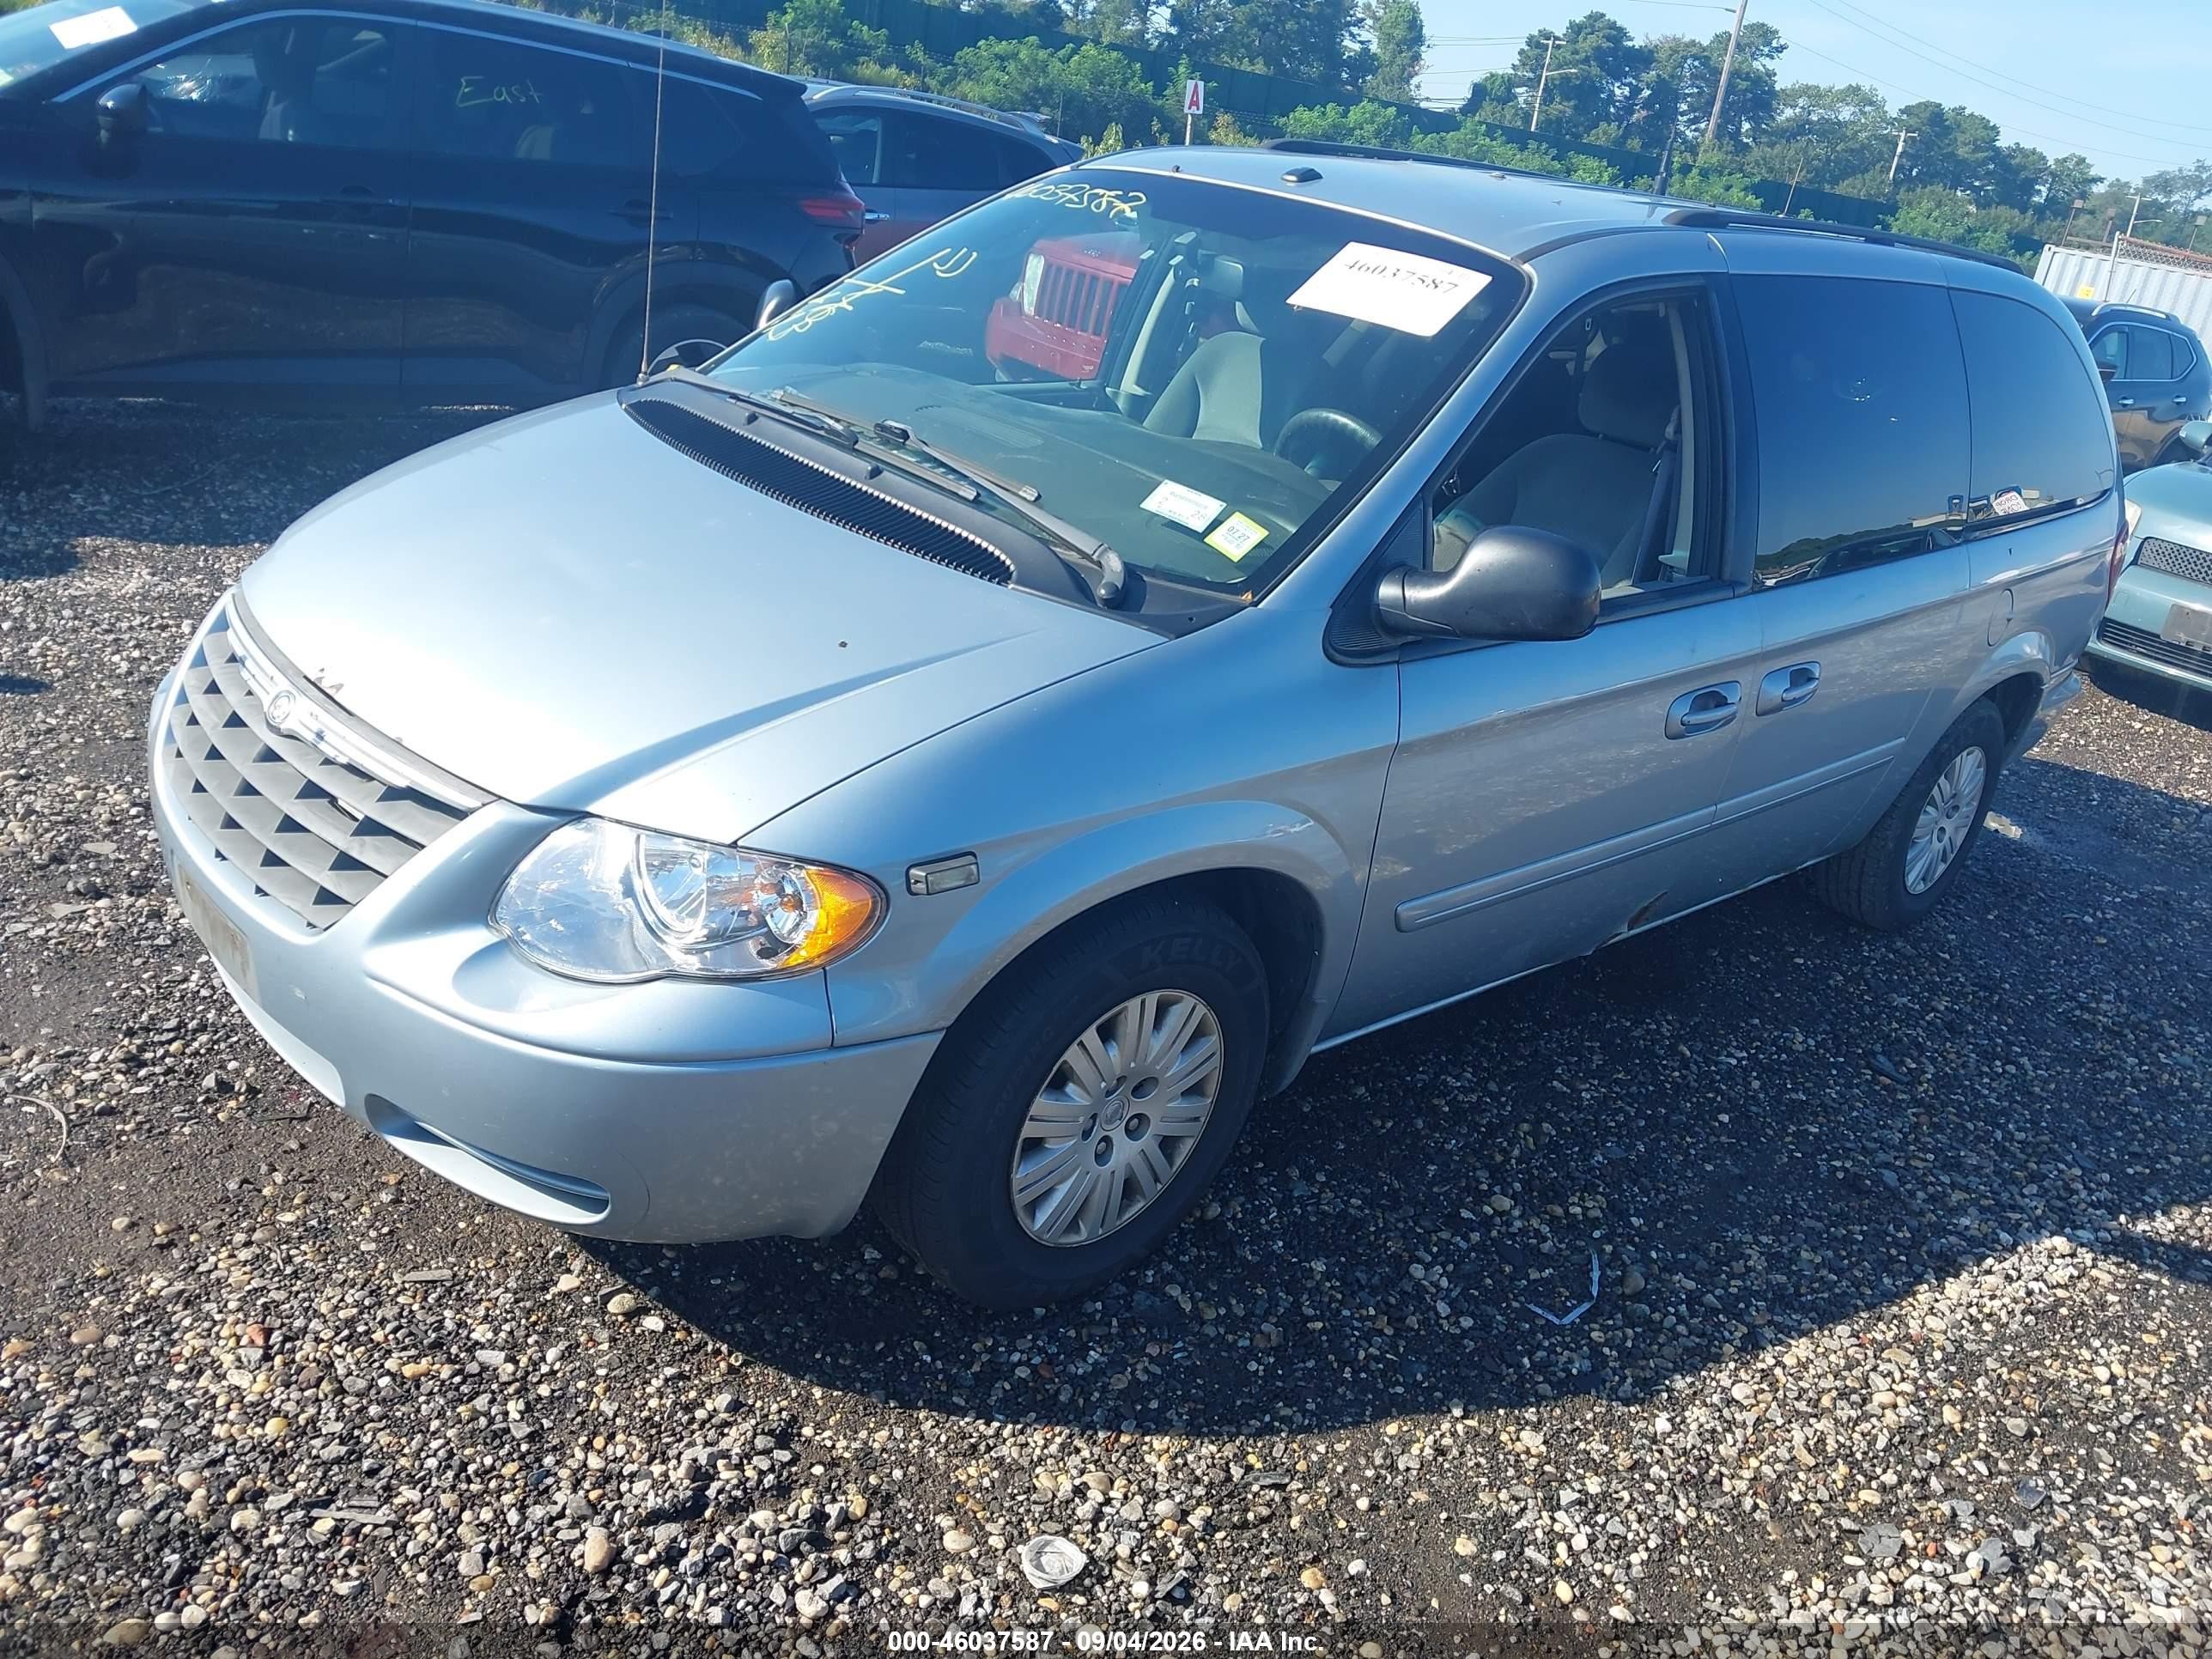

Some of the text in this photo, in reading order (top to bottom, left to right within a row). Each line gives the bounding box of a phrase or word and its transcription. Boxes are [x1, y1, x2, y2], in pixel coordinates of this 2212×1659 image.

[456, 76, 543, 107] East
[1188, 81, 1200, 112] A
[1344, 259, 1459, 294] 46037587
[1140, 936, 1244, 975] KELLY
